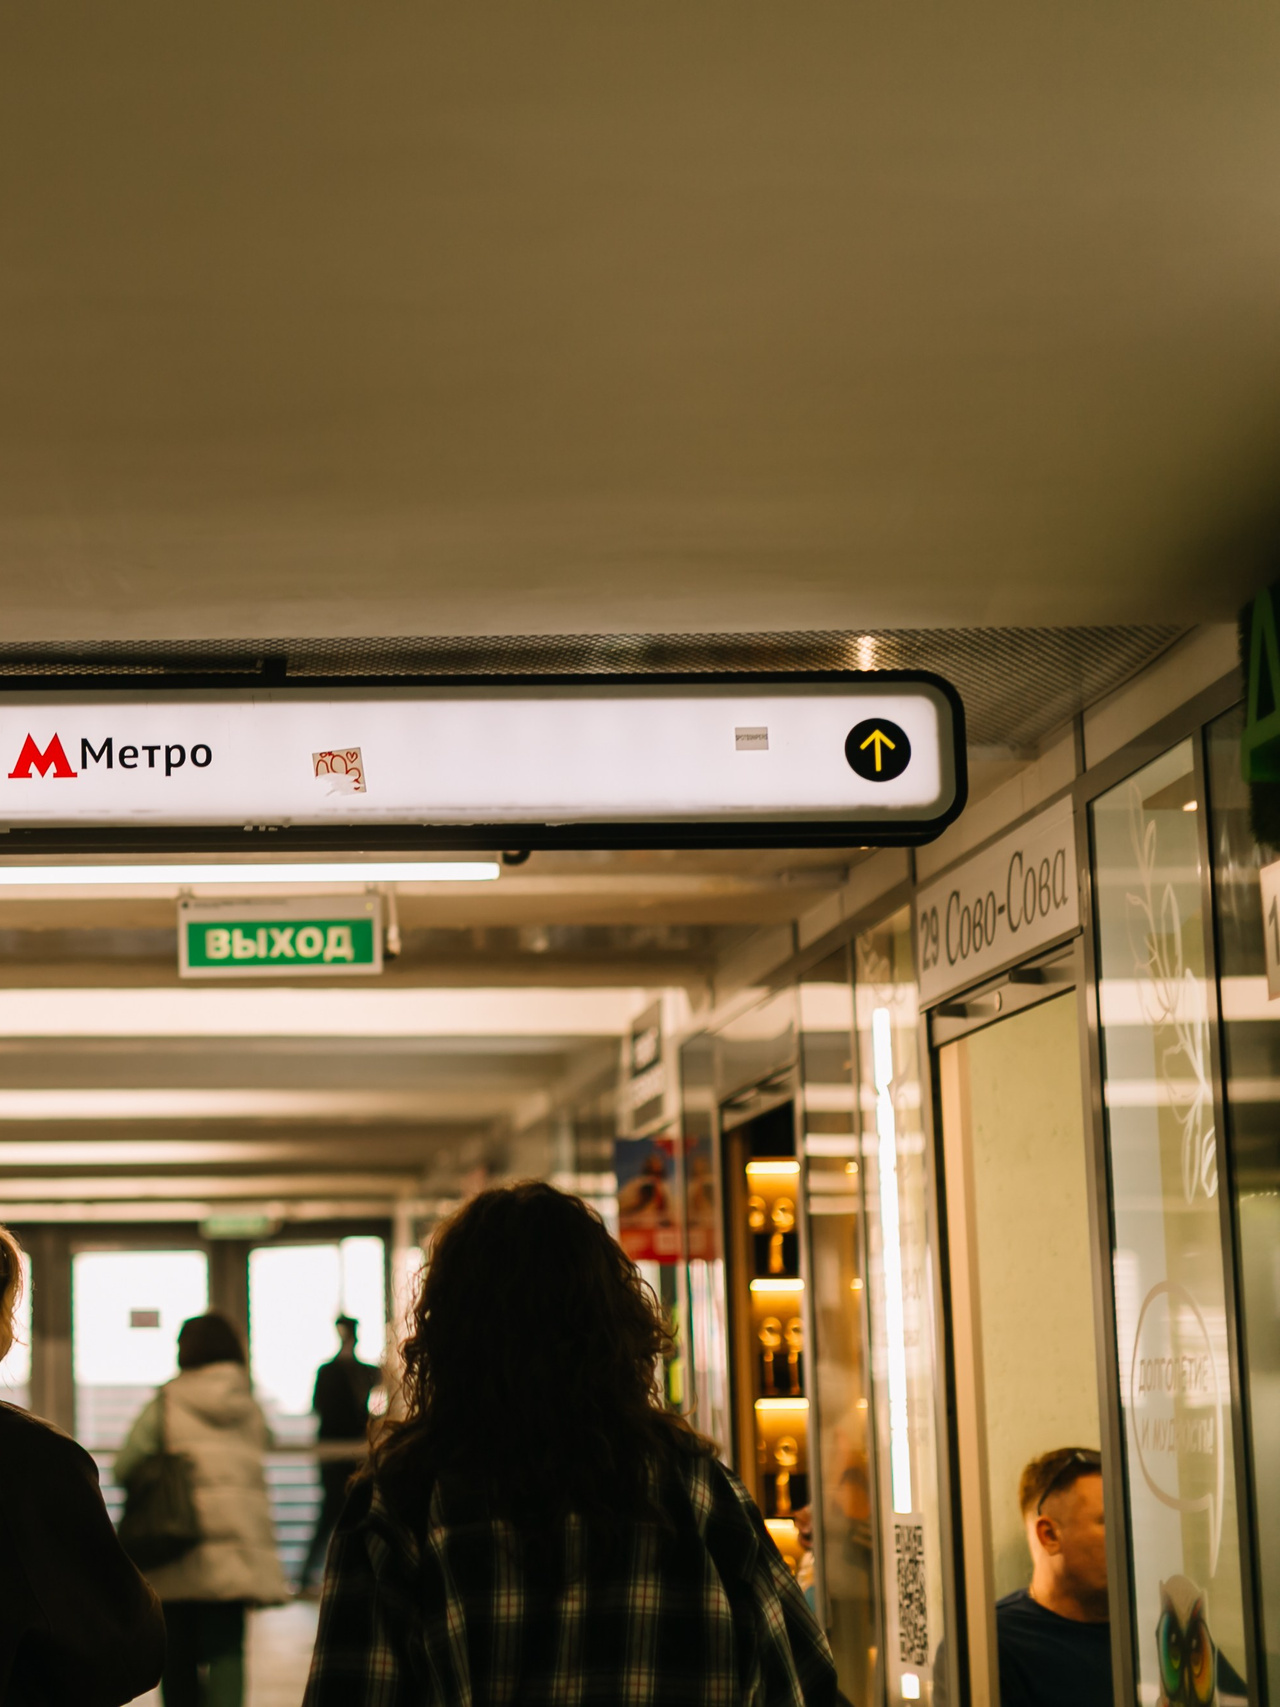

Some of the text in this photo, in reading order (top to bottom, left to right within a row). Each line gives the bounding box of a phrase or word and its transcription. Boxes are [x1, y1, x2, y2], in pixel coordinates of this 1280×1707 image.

[80, 738, 213, 778] Метро
[921, 848, 1069, 973] 29 Сово-Сова
[205, 926, 355, 963] ВЫХОД
